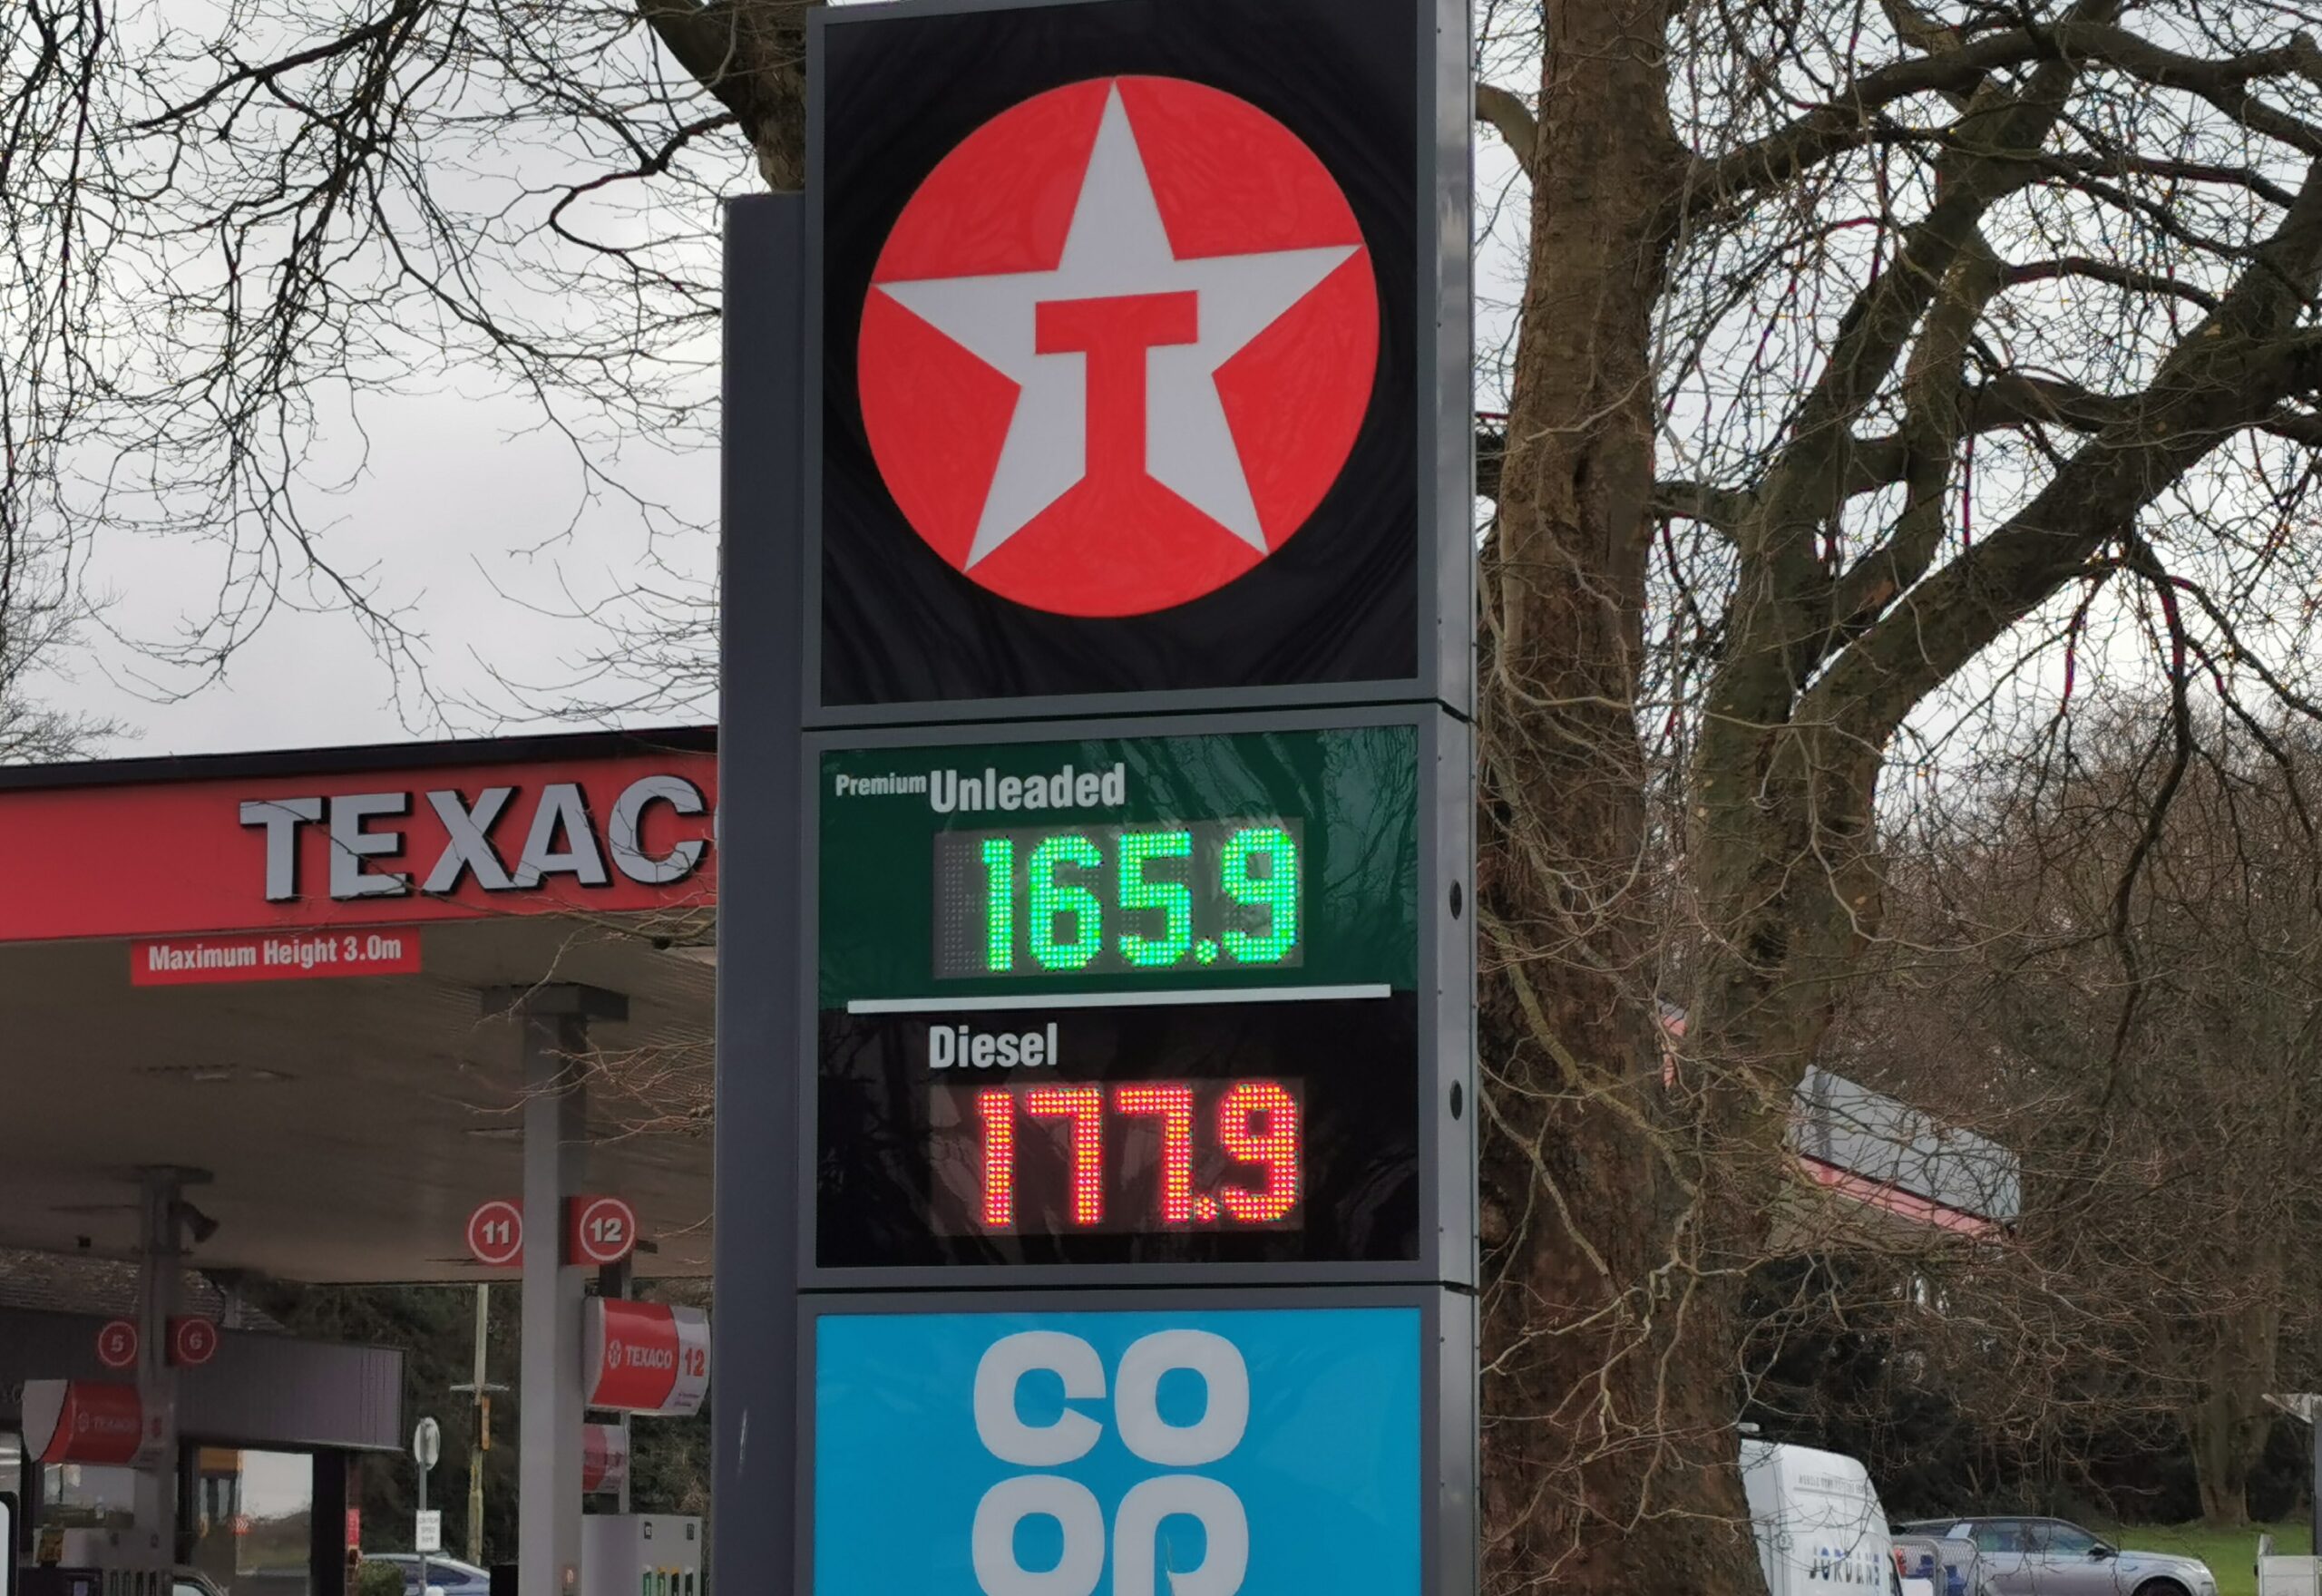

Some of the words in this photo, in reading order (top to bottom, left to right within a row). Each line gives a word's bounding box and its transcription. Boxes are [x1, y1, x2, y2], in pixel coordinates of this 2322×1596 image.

[835, 772, 927, 797] Premium
[930, 762, 1126, 813] Unleaded
[239, 774, 719, 903] TEXAC
[981, 826, 1299, 972] 165.9
[148, 943, 257, 972] Maximum
[263, 937, 337, 969] Height
[343, 935, 402, 962] 3.0m
[929, 1022, 1059, 1069] Diesel
[979, 1083, 1299, 1226] 177.9
[482, 1220, 510, 1245] 11
[590, 1217, 622, 1242] 12
[111, 1334, 124, 1354] 5
[189, 1331, 203, 1351] 6
[624, 1345, 674, 1369] TEXACO
[684, 1348, 706, 1377] 12
